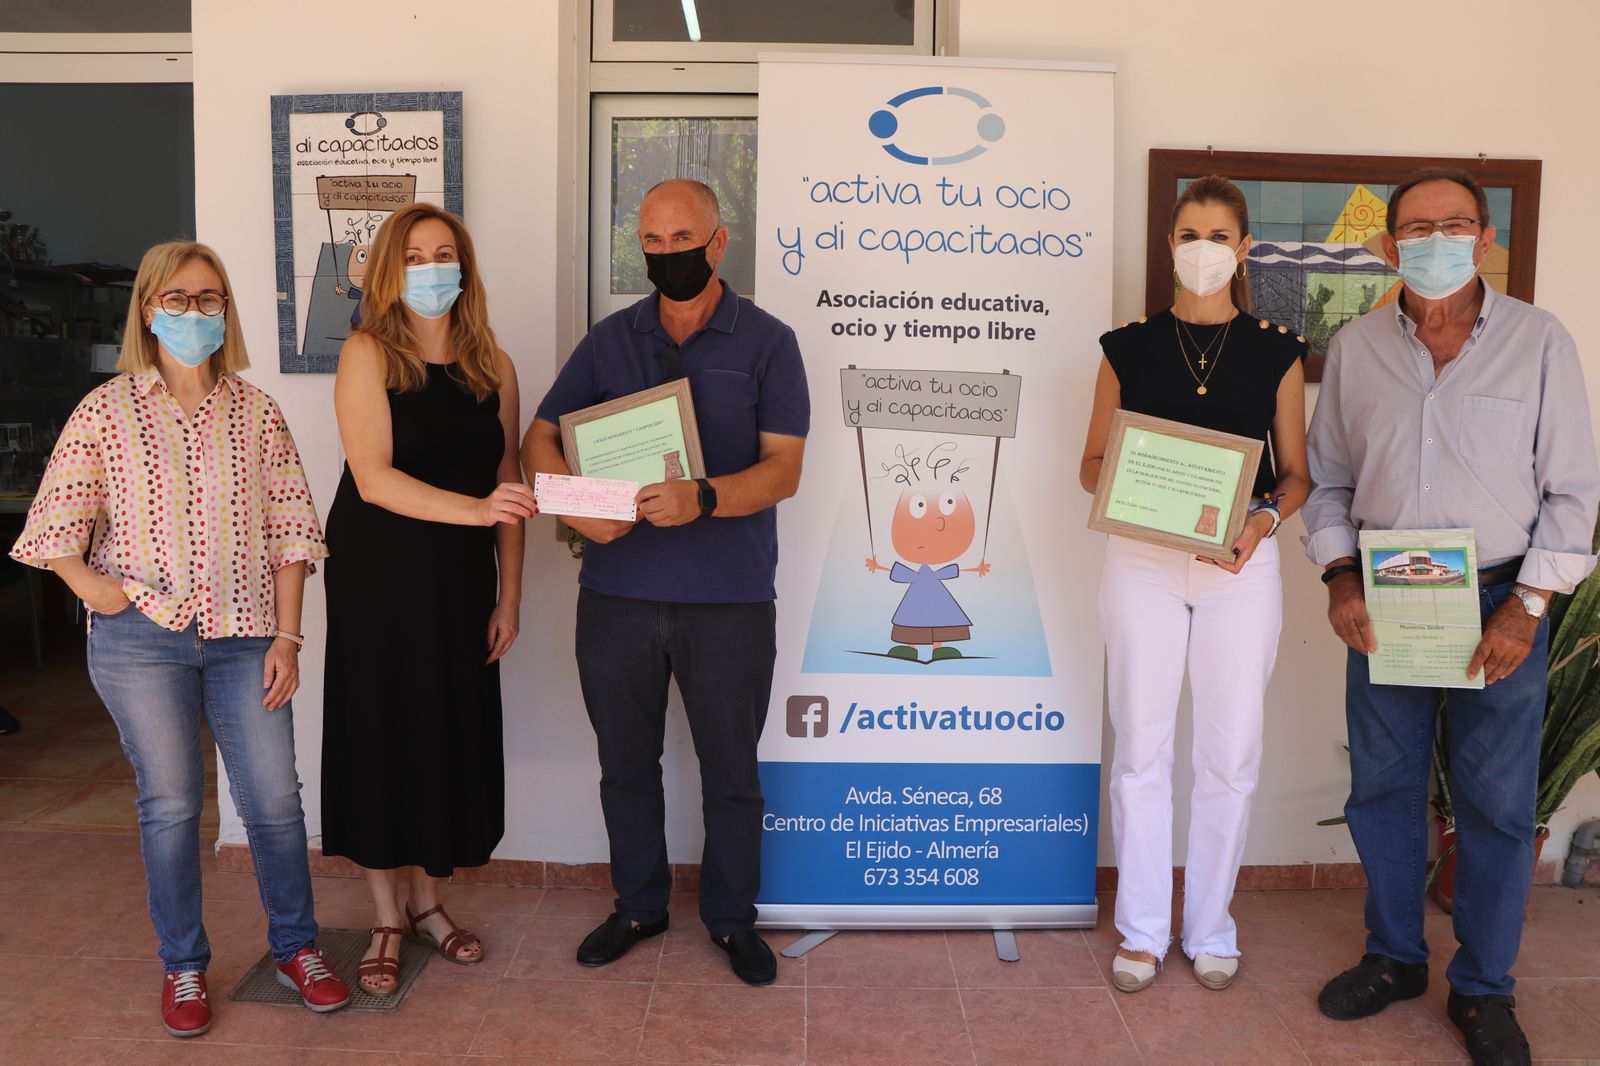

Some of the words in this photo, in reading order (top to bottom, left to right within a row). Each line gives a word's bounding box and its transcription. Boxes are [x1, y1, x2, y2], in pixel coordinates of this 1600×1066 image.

[296, 136, 312, 153] di
[318, 134, 439, 159] capacitados
[388, 158, 395, 168] y
[397, 156, 422, 165] tiempo
[423, 155, 438, 164] libre
[382, 181, 403, 189] ocio
[802, 174, 921, 205] "activa
[936, 176, 982, 207] tu
[995, 180, 1071, 211] ocio
[322, 193, 330, 207] y
[332, 192, 342, 201] di
[777, 226, 806, 276] y
[815, 221, 845, 251] di
[858, 224, 1093, 264] capacitados"
[816, 289, 933, 310] Asociación
[940, 291, 1050, 316] educativa,
[831, 318, 877, 337] ocio
[884, 323, 897, 342] y
[903, 320, 981, 344] tiempo
[987, 321, 1036, 341] libre
[861, 373, 922, 392] "activa
[929, 376, 953, 395] tu
[958, 381, 998, 398] ocio
[847, 399, 861, 425] y
[866, 398, 882, 414] di
[888, 401, 1008, 422] capacitados"
[839, 702, 1065, 734] /activatuocio
[845, 786, 897, 806] Avda.
[901, 786, 974, 808] Séneca,
[978, 786, 1002, 806] 68
[830, 813, 854, 832] de
[859, 813, 949, 832] Iniciativas
[954, 813, 1089, 837] Empresariales)
[846, 841, 862, 859] El
[866, 841, 911, 863] Ejido
[926, 840, 999, 859] Almería
[864, 868, 899, 886] 673
[903, 868, 939, 886] 354
[944, 868, 979, 886] 608
